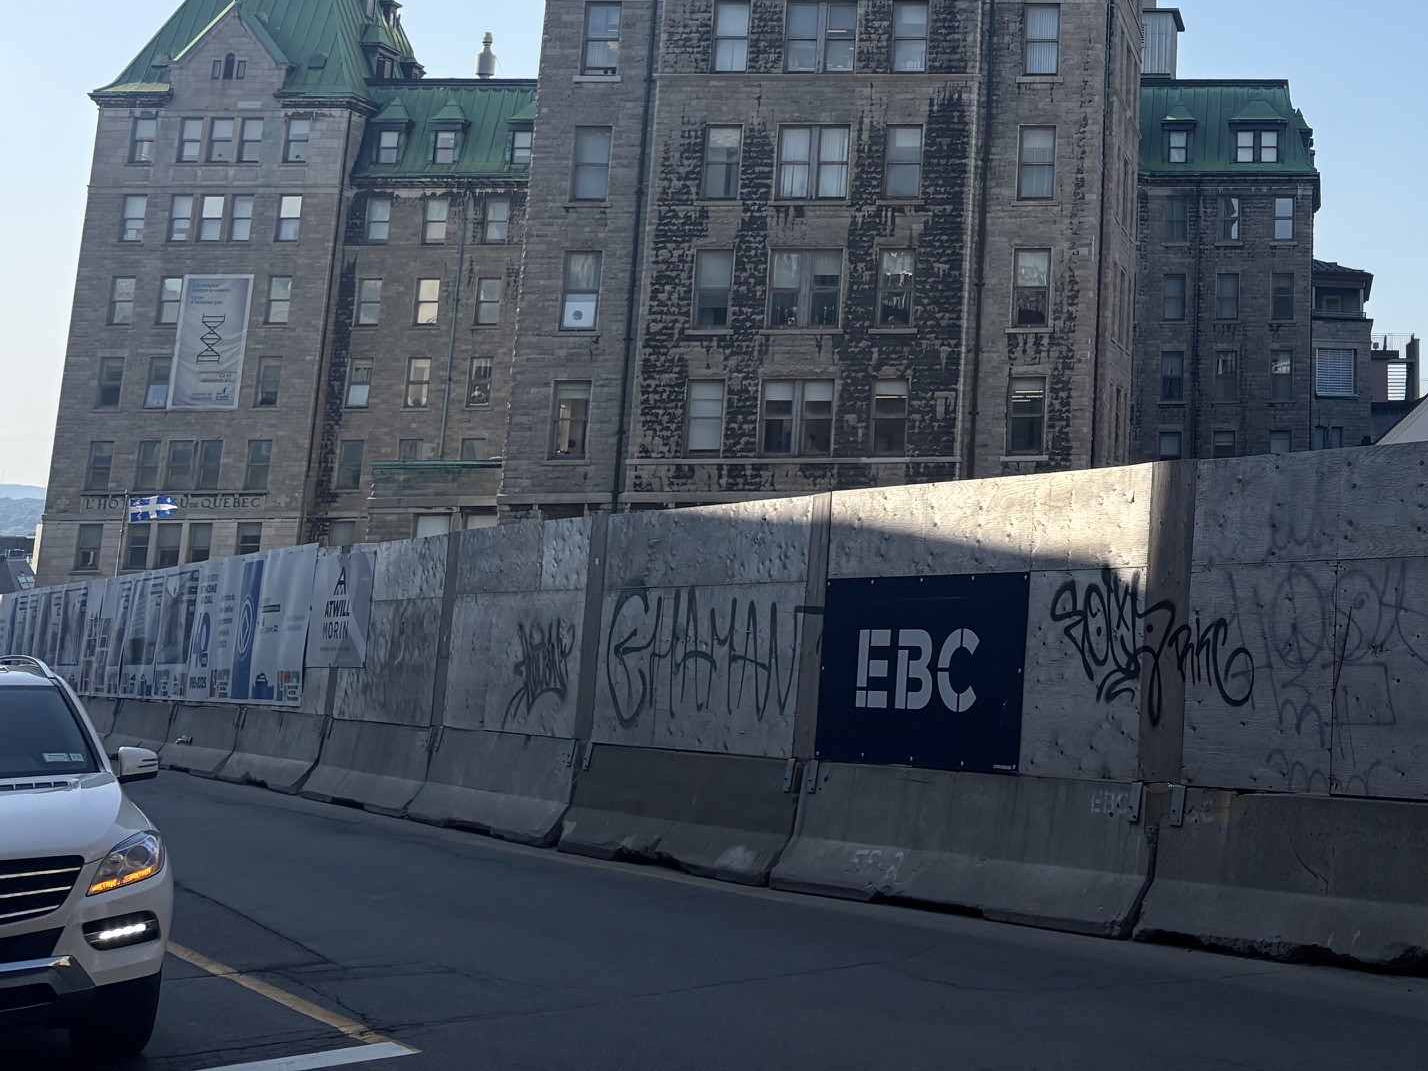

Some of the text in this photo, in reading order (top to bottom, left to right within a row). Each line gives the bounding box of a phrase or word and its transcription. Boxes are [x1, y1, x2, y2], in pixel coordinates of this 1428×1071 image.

[324, 599, 351, 618] ATWILL
[322, 620, 350, 640] MORIN
[855, 627, 980, 714] EBC
